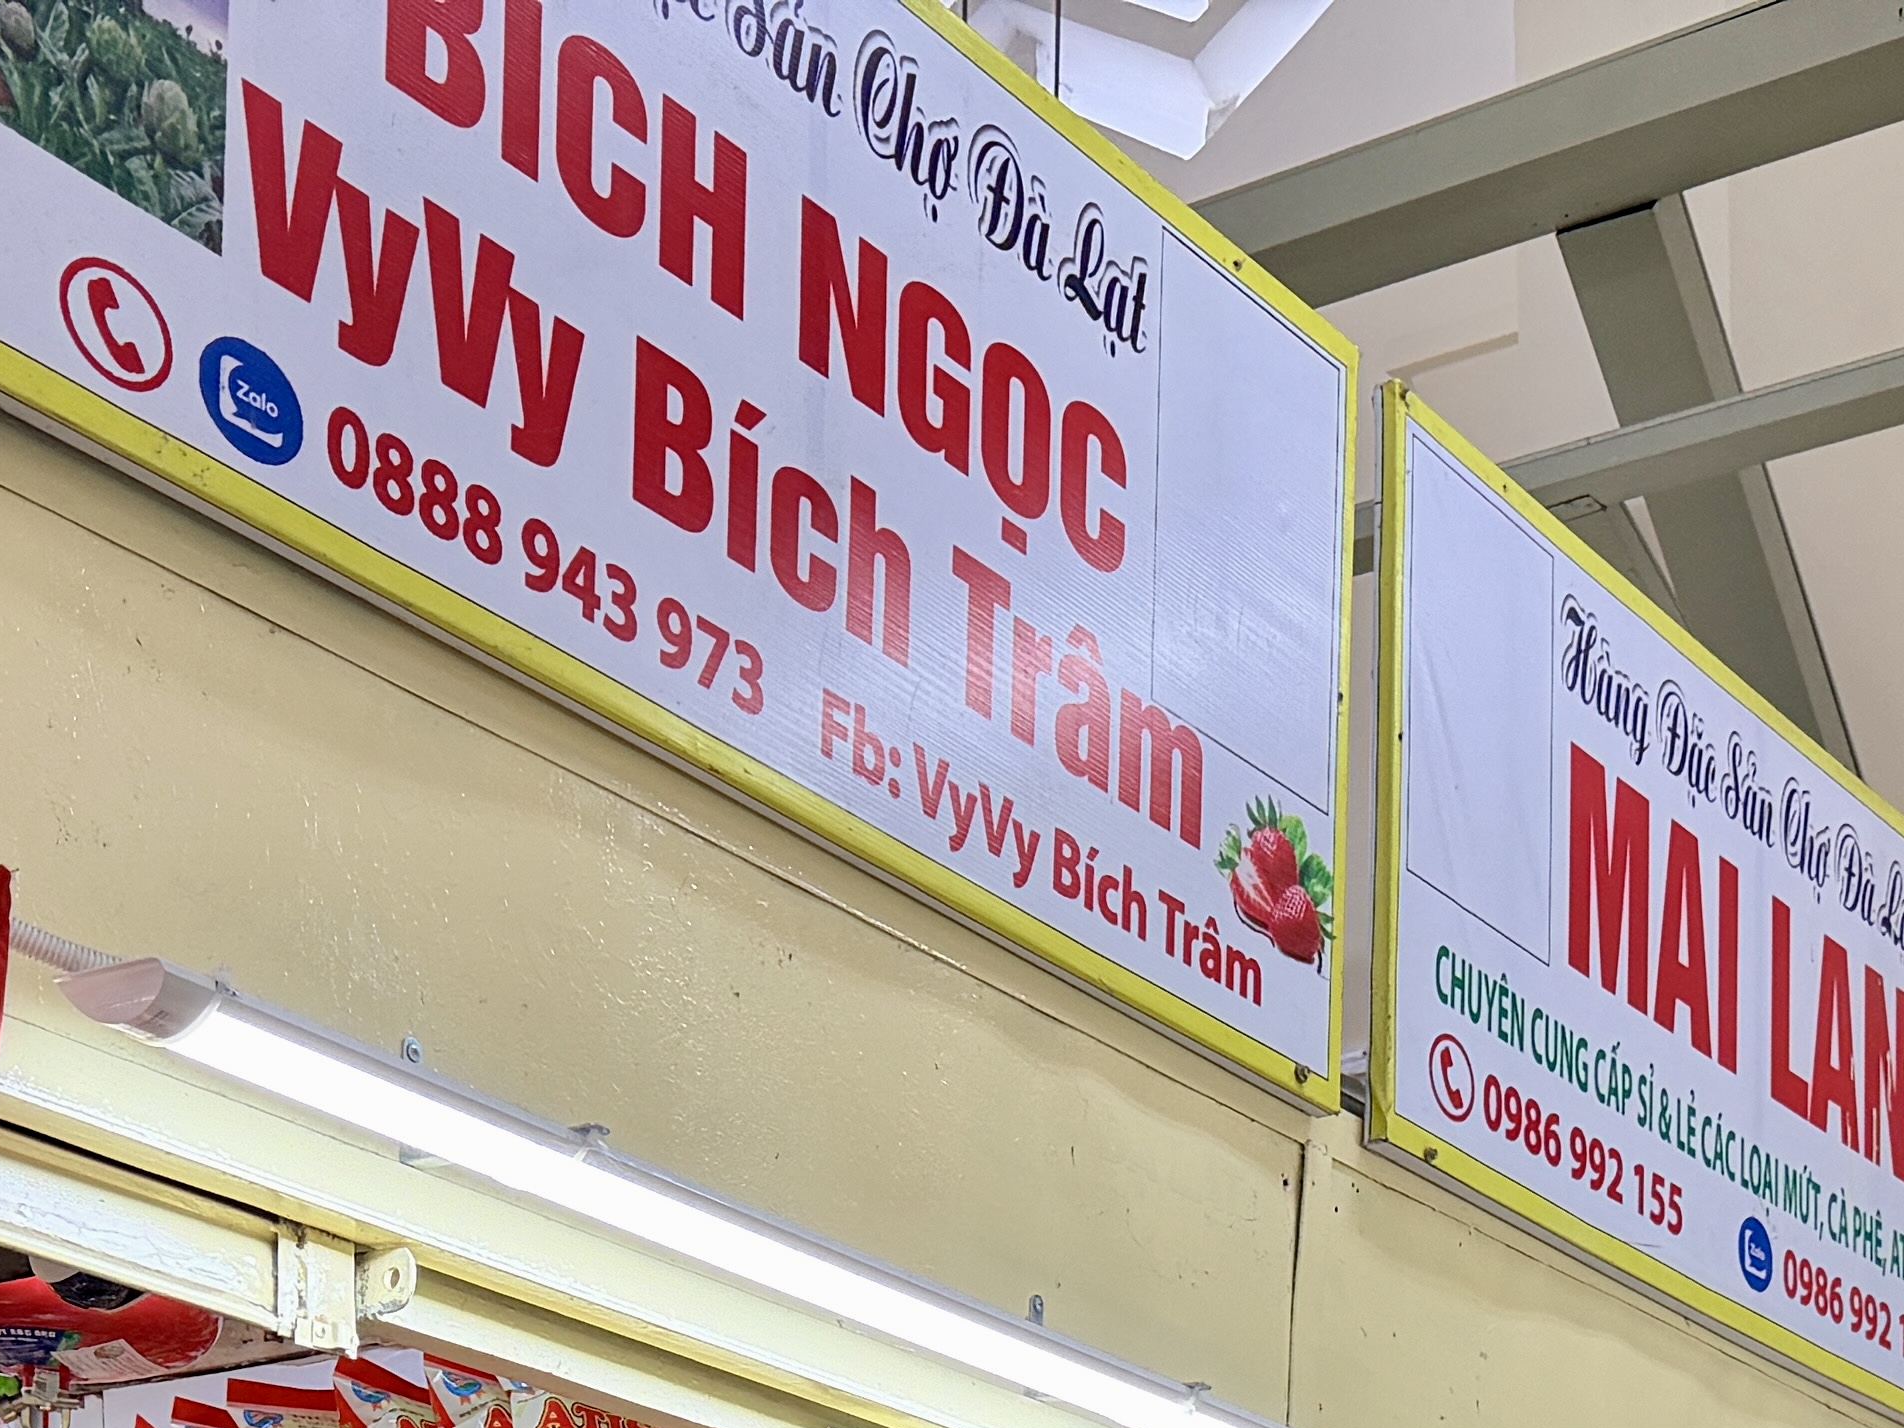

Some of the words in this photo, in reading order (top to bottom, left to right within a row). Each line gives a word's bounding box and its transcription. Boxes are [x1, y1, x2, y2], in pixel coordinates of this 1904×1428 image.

[854, 30, 959, 222] Chợ
[969, 125, 1053, 281] Đà
[1058, 202, 1148, 357] Lạt
[235, 378, 279, 419] Zalo
[241, 76, 585, 468] VyVy
[632, 333, 910, 666] Bích
[951, 541, 1203, 849] Trâm
[798, 193, 1127, 574] NGỌC
[327, 406, 503, 565] 0888
[522, 517, 638, 643] 943
[658, 594, 764, 715] 973
[819, 687, 902, 797] Fb:
[914, 740, 1041, 889] VyVy
[1051, 837, 1146, 943] Bích
[1157, 889, 1263, 1005] Trâm
[1561, 593, 1649, 766] Hàng
[1656, 679, 1717, 808] Đặc
[1720, 731, 1774, 848] Sản
[1781, 777, 1831, 904] Chợ
[1834, 824, 1874, 926] Đà
[1569, 741, 1737, 1076] MAI
[1435, 945, 1525, 1053] CHUYÊN
[1531, 1007, 1589, 1093] CUNG
[1594, 1041, 1632, 1116] CẤP
[1637, 1063, 1654, 1132] SỈ
[1658, 1088, 1672, 1144] &
[1676, 1089, 1696, 1159] LẺ
[1701, 1112, 1736, 1182] CÁC
[1740, 1137, 1778, 1217] LOẠI
[1783, 1164, 1824, 1241] MỨT,
[1828, 1187, 1849, 1249] CÀ
[1853, 1205, 1887, 1277] PHÊ,
[1483, 1073, 1561, 1167] 0986
[1570, 1126, 1623, 1205] 992
[1634, 1163, 1683, 1236] 155
[1783, 1249, 1843, 1324] 0986
[1849, 1286, 1892, 1350] 992
